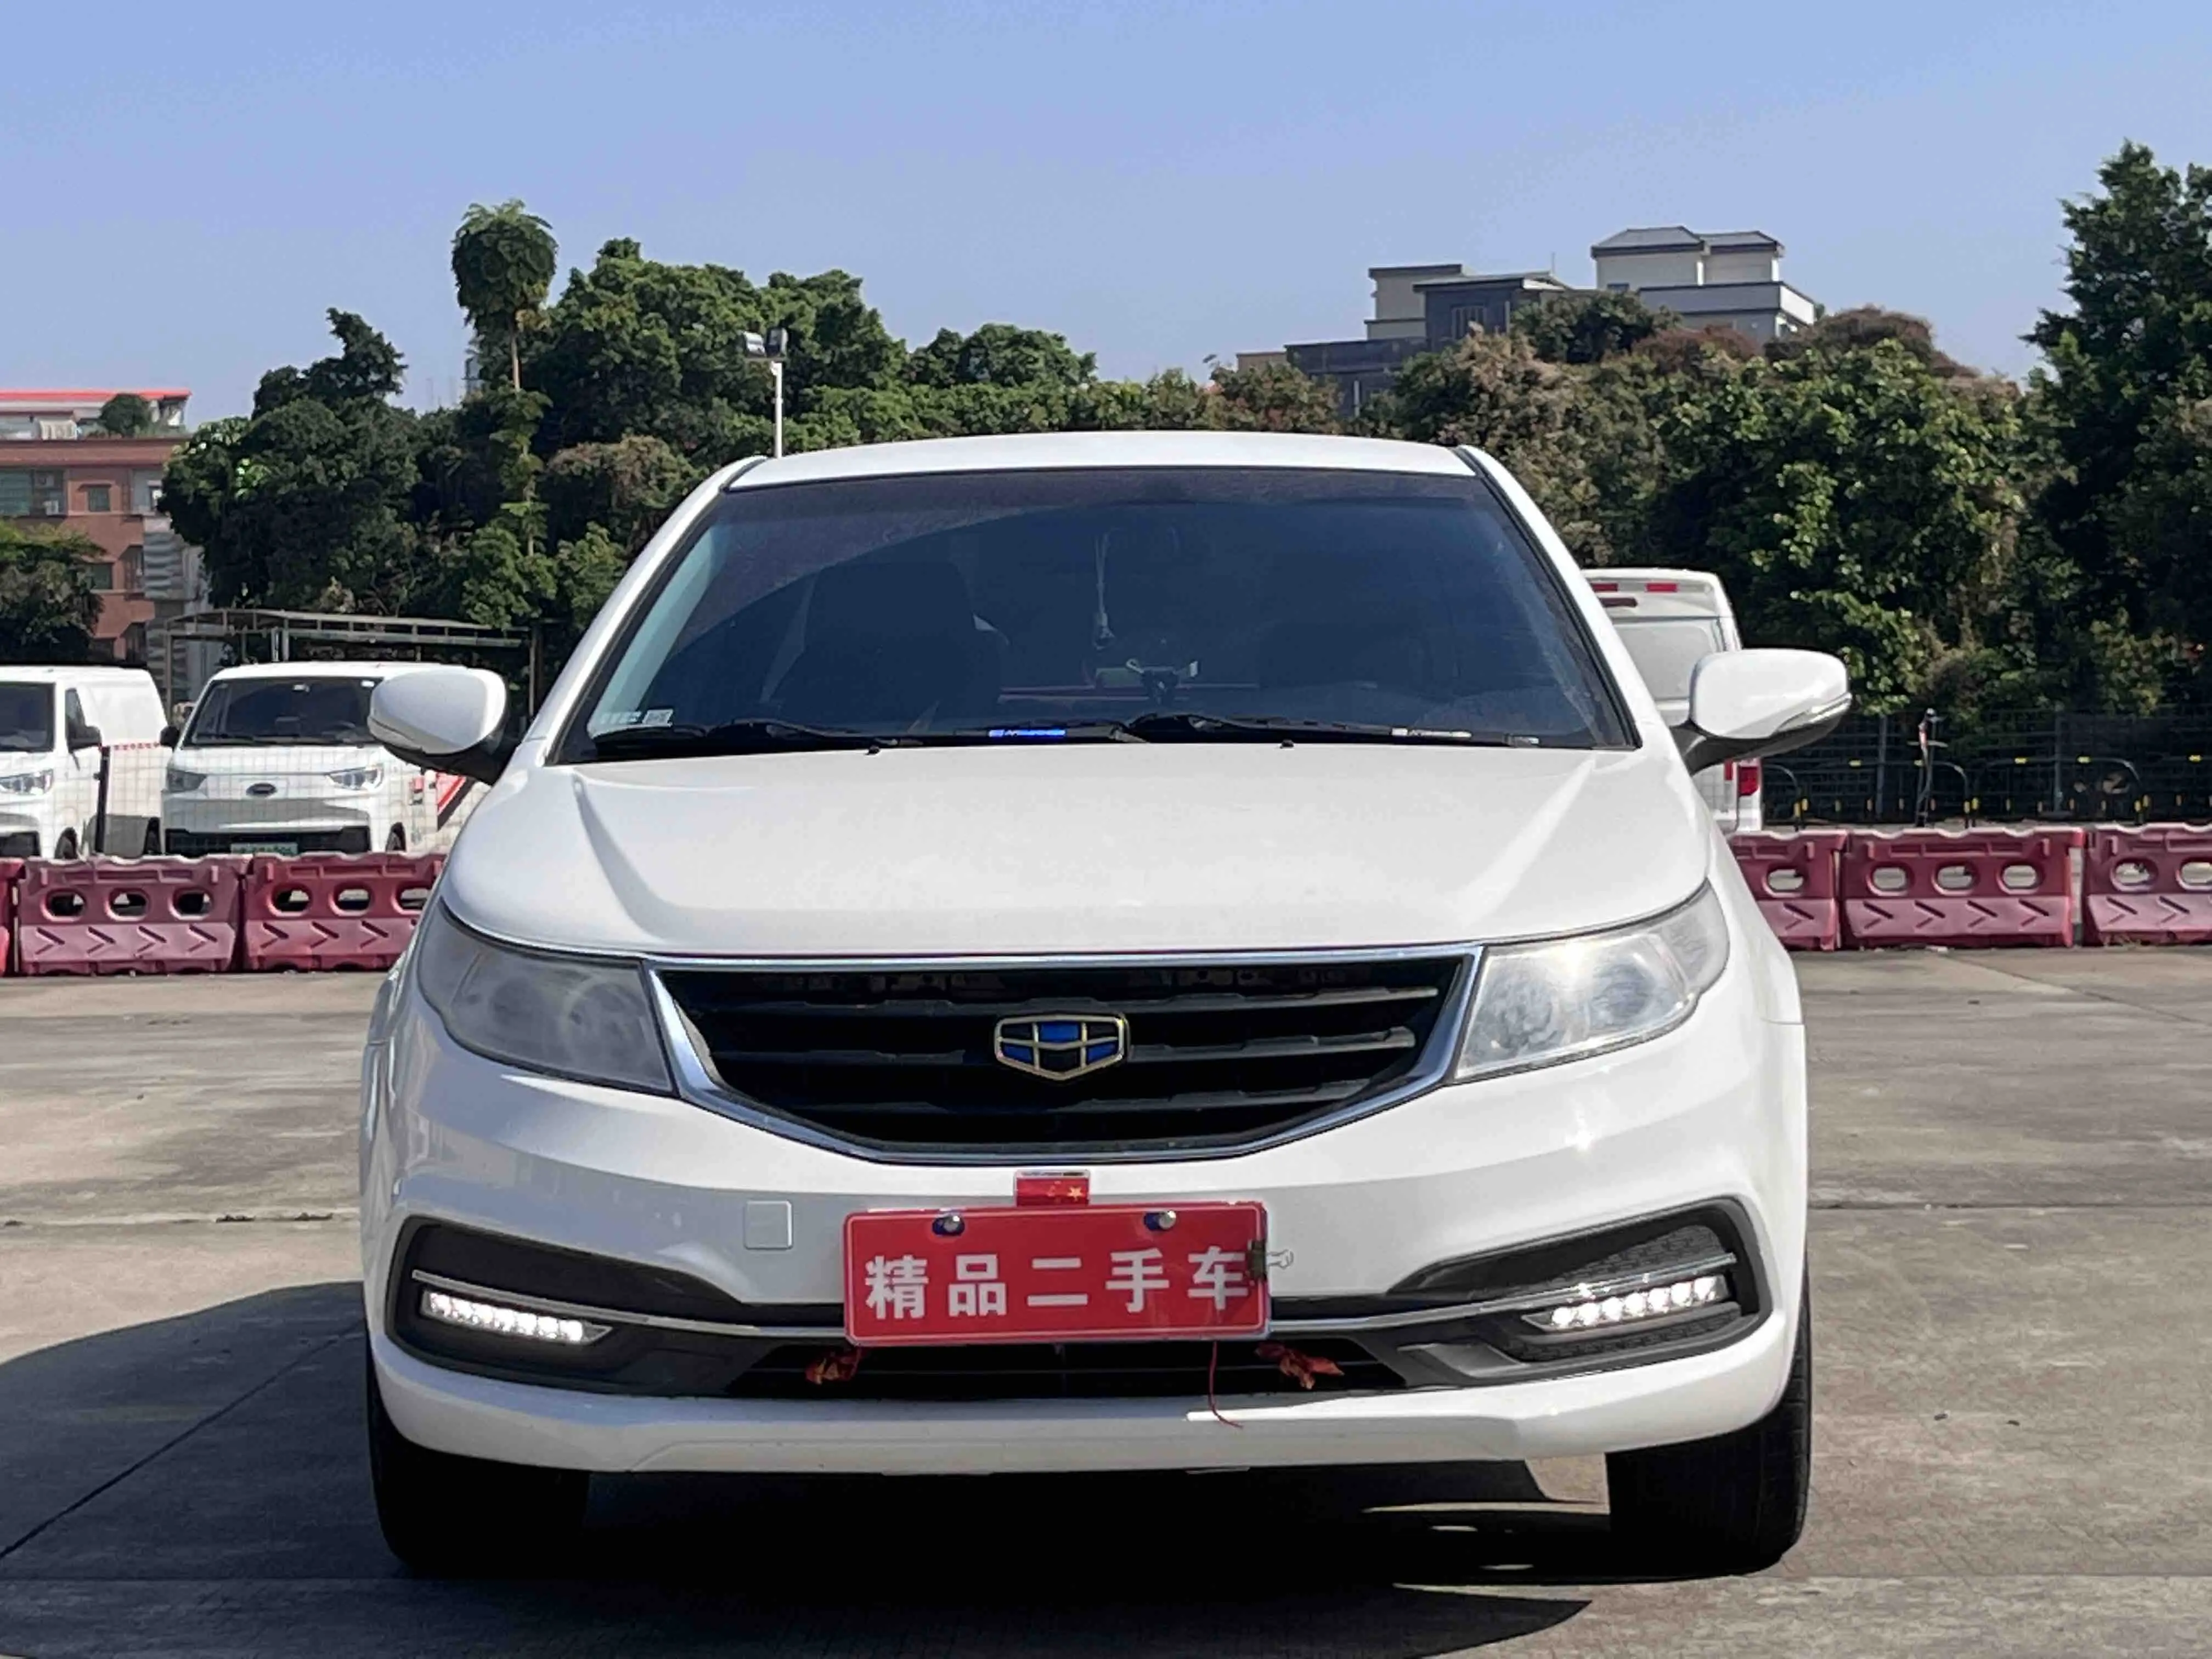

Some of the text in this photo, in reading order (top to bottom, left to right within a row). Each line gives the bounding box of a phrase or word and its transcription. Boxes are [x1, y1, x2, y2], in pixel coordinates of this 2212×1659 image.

[864, 1246, 1249, 1319] 精品二手车
